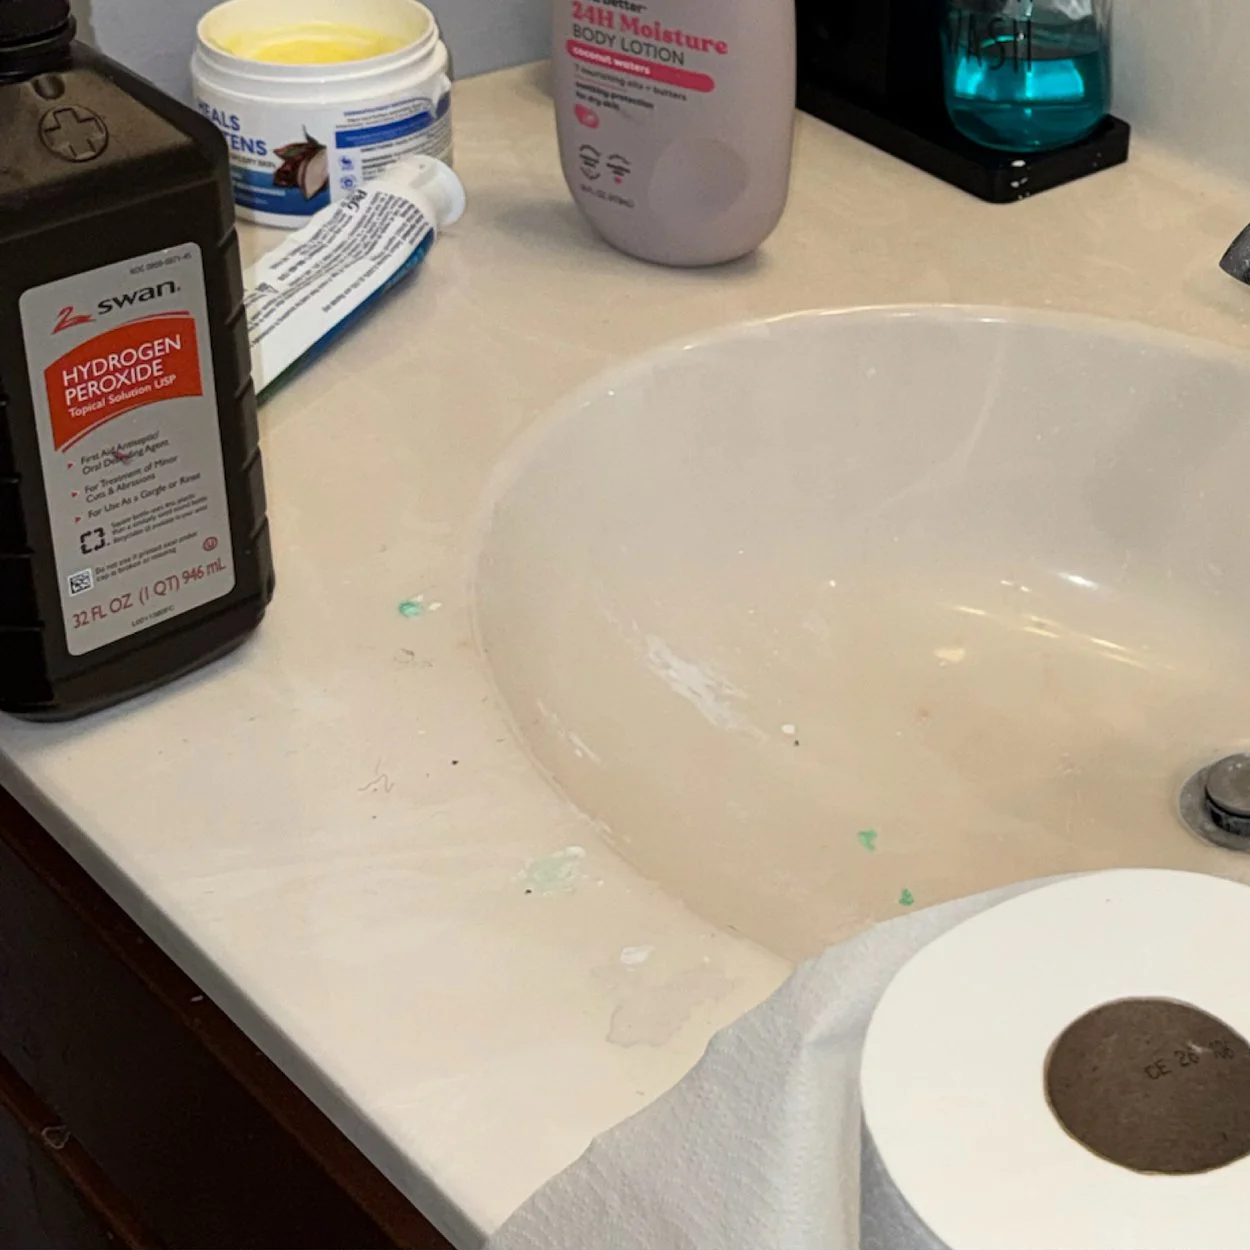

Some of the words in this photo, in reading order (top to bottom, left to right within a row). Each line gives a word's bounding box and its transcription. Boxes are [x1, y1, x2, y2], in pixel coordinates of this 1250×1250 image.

[572, 1, 614, 29] 24H
[619, 13, 728, 55] Moisture
[572, 23, 617, 47] BODY
[621, 37, 685, 66] LOTION
[572, 46, 613, 65] coconut
[614, 58, 651, 75] waters
[652, 86, 687, 101] butters
[62, 334, 182, 387] HYDROGEN
[65, 359, 164, 406] PEROXIDE
[68, 398, 106, 418] Topical
[109, 385, 151, 404] Solution
[154, 374, 177, 389] USP
[81, 453, 99, 465] First
[82, 462, 101, 475] Oral
[145, 439, 170, 453] Agent
[85, 483, 98, 494] For
[100, 468, 142, 487] Treatment
[144, 462, 152, 472] of
[86, 491, 106, 503] Cuts
[116, 473, 156, 491] Abrasions
[88, 508, 102, 518] For
[104, 503, 120, 512] Use
[121, 497, 132, 506] As
[140, 485, 167, 500] Gargle
[168, 480, 178, 489] or
[72, 611, 89, 629] 32
[90, 604, 107, 621] FL
[109, 593, 134, 614] OZ
[153, 575, 181, 596] QT)
[182, 565, 205, 585] 946
[206, 557, 227, 576] mL
